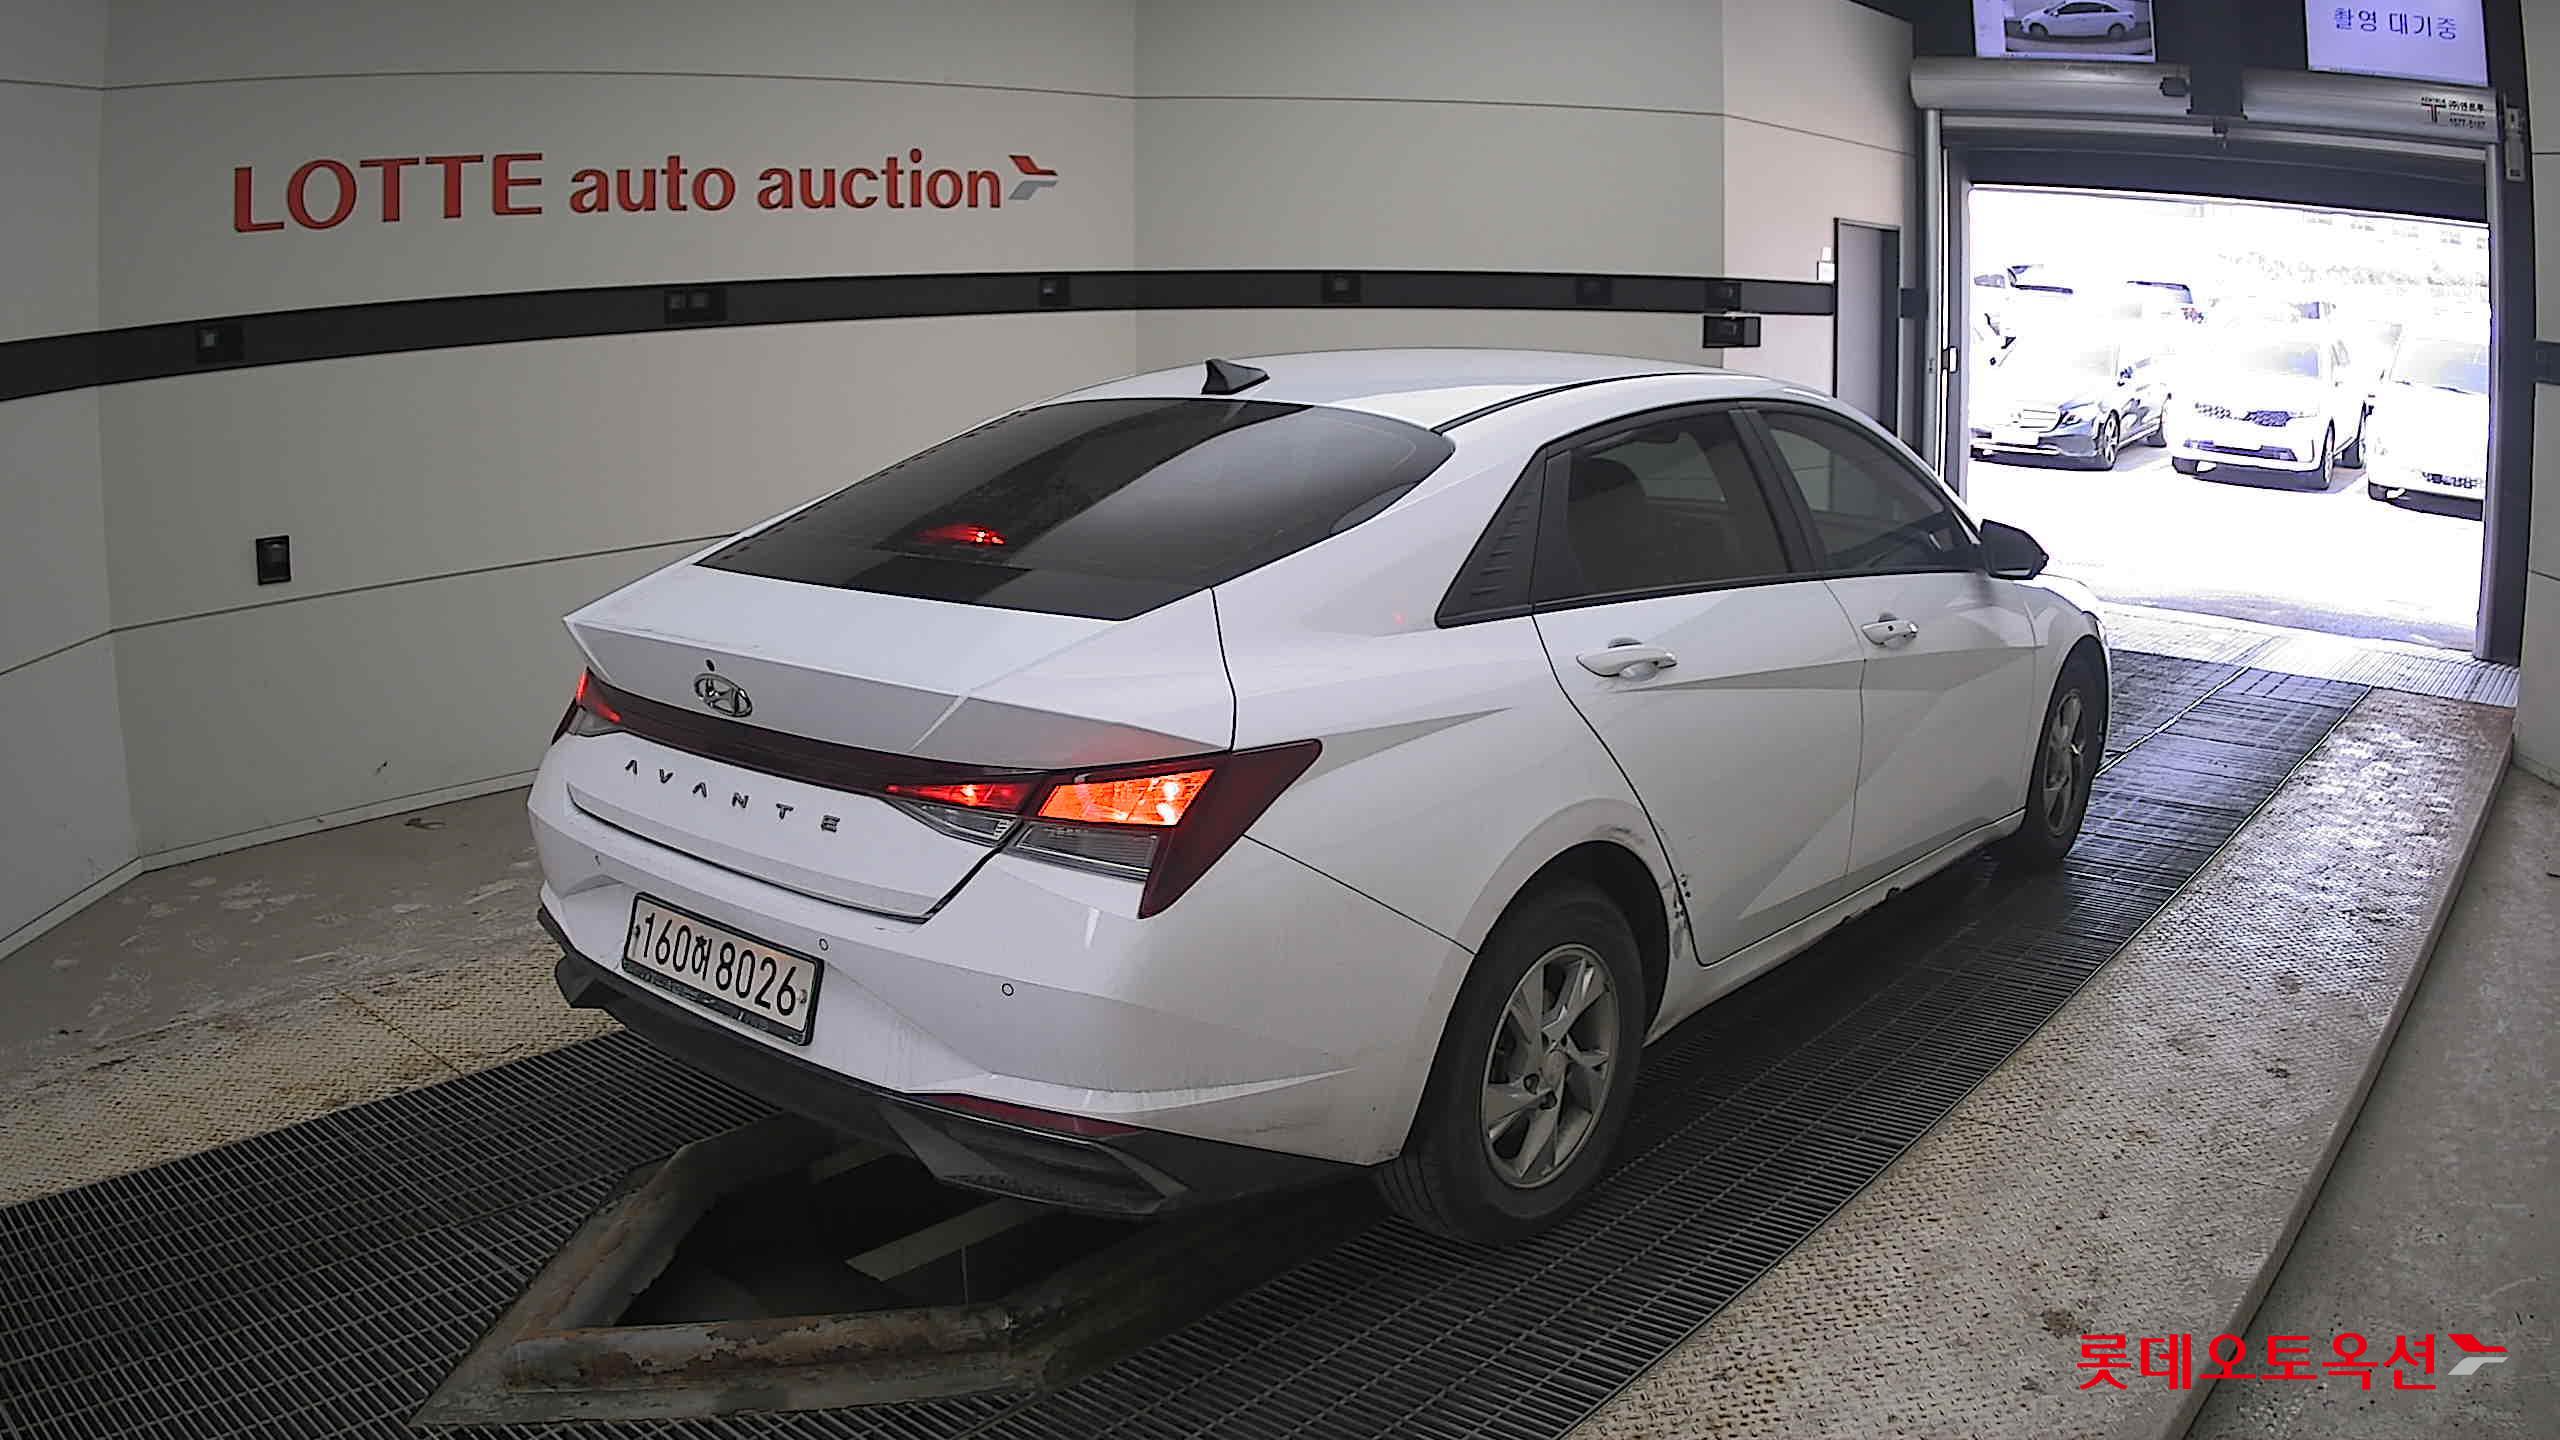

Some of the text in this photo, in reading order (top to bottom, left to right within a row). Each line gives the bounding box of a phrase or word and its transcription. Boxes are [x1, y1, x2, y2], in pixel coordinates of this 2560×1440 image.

[2334, 7, 2378, 32] 촬영
[233, 148, 1003, 233] LOTTE auto auction
[625, 759, 840, 832] AVANTE
